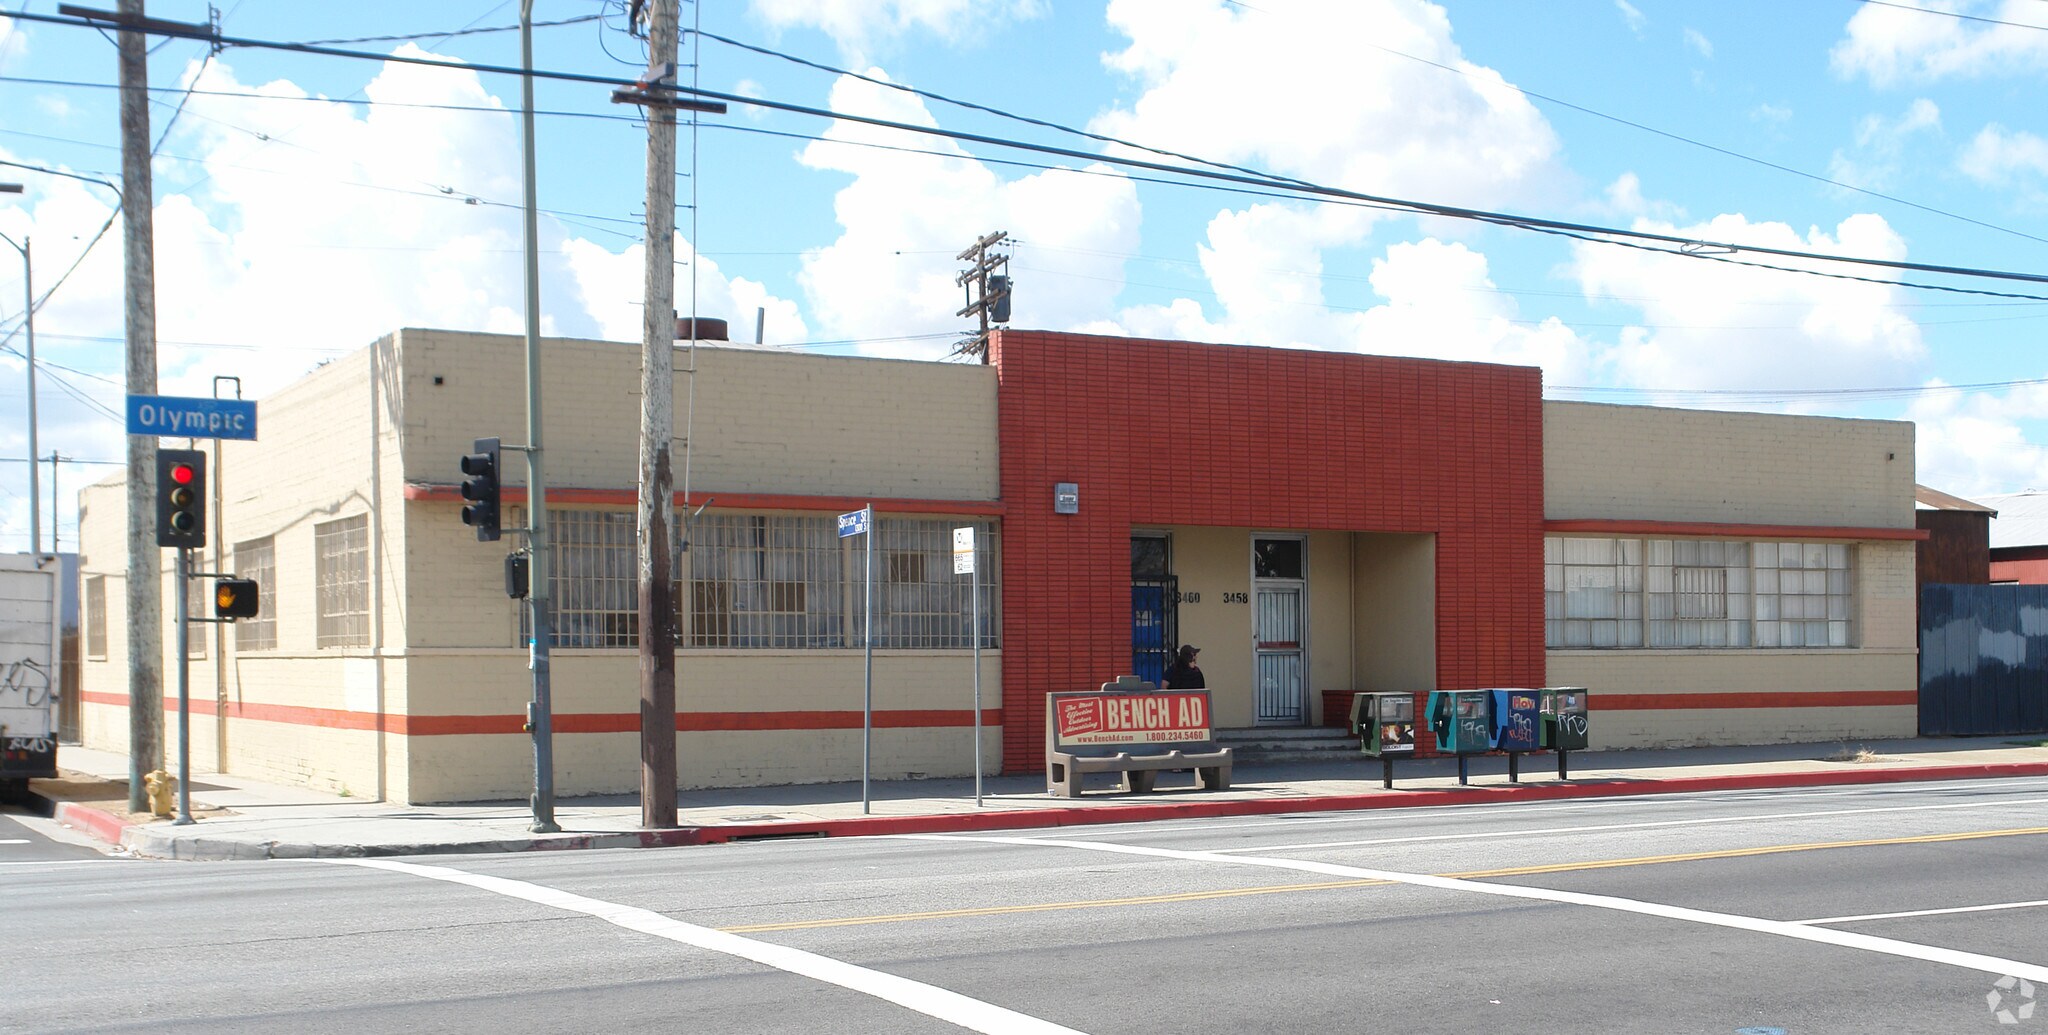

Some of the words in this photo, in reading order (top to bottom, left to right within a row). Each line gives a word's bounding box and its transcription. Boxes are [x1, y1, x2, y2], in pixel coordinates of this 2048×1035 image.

[139, 404, 245, 432] Olympic
[839, 516, 856, 530] Spence
[1223, 592, 1248, 604] 3458
[1079, 701, 1094, 709] Most
[1512, 695, 1536, 710] Hoy
[1066, 709, 1094, 719] Effective
[1107, 698, 1170, 729] BENCH
[1178, 697, 1203, 727] AD
[1068, 716, 1091, 725] Outdoor
[1064, 722, 1098, 734] Advertising
[1077, 734, 1133, 743] www.BenchAd.com
[1146, 731, 1203, 741] 1.800.234.5460
